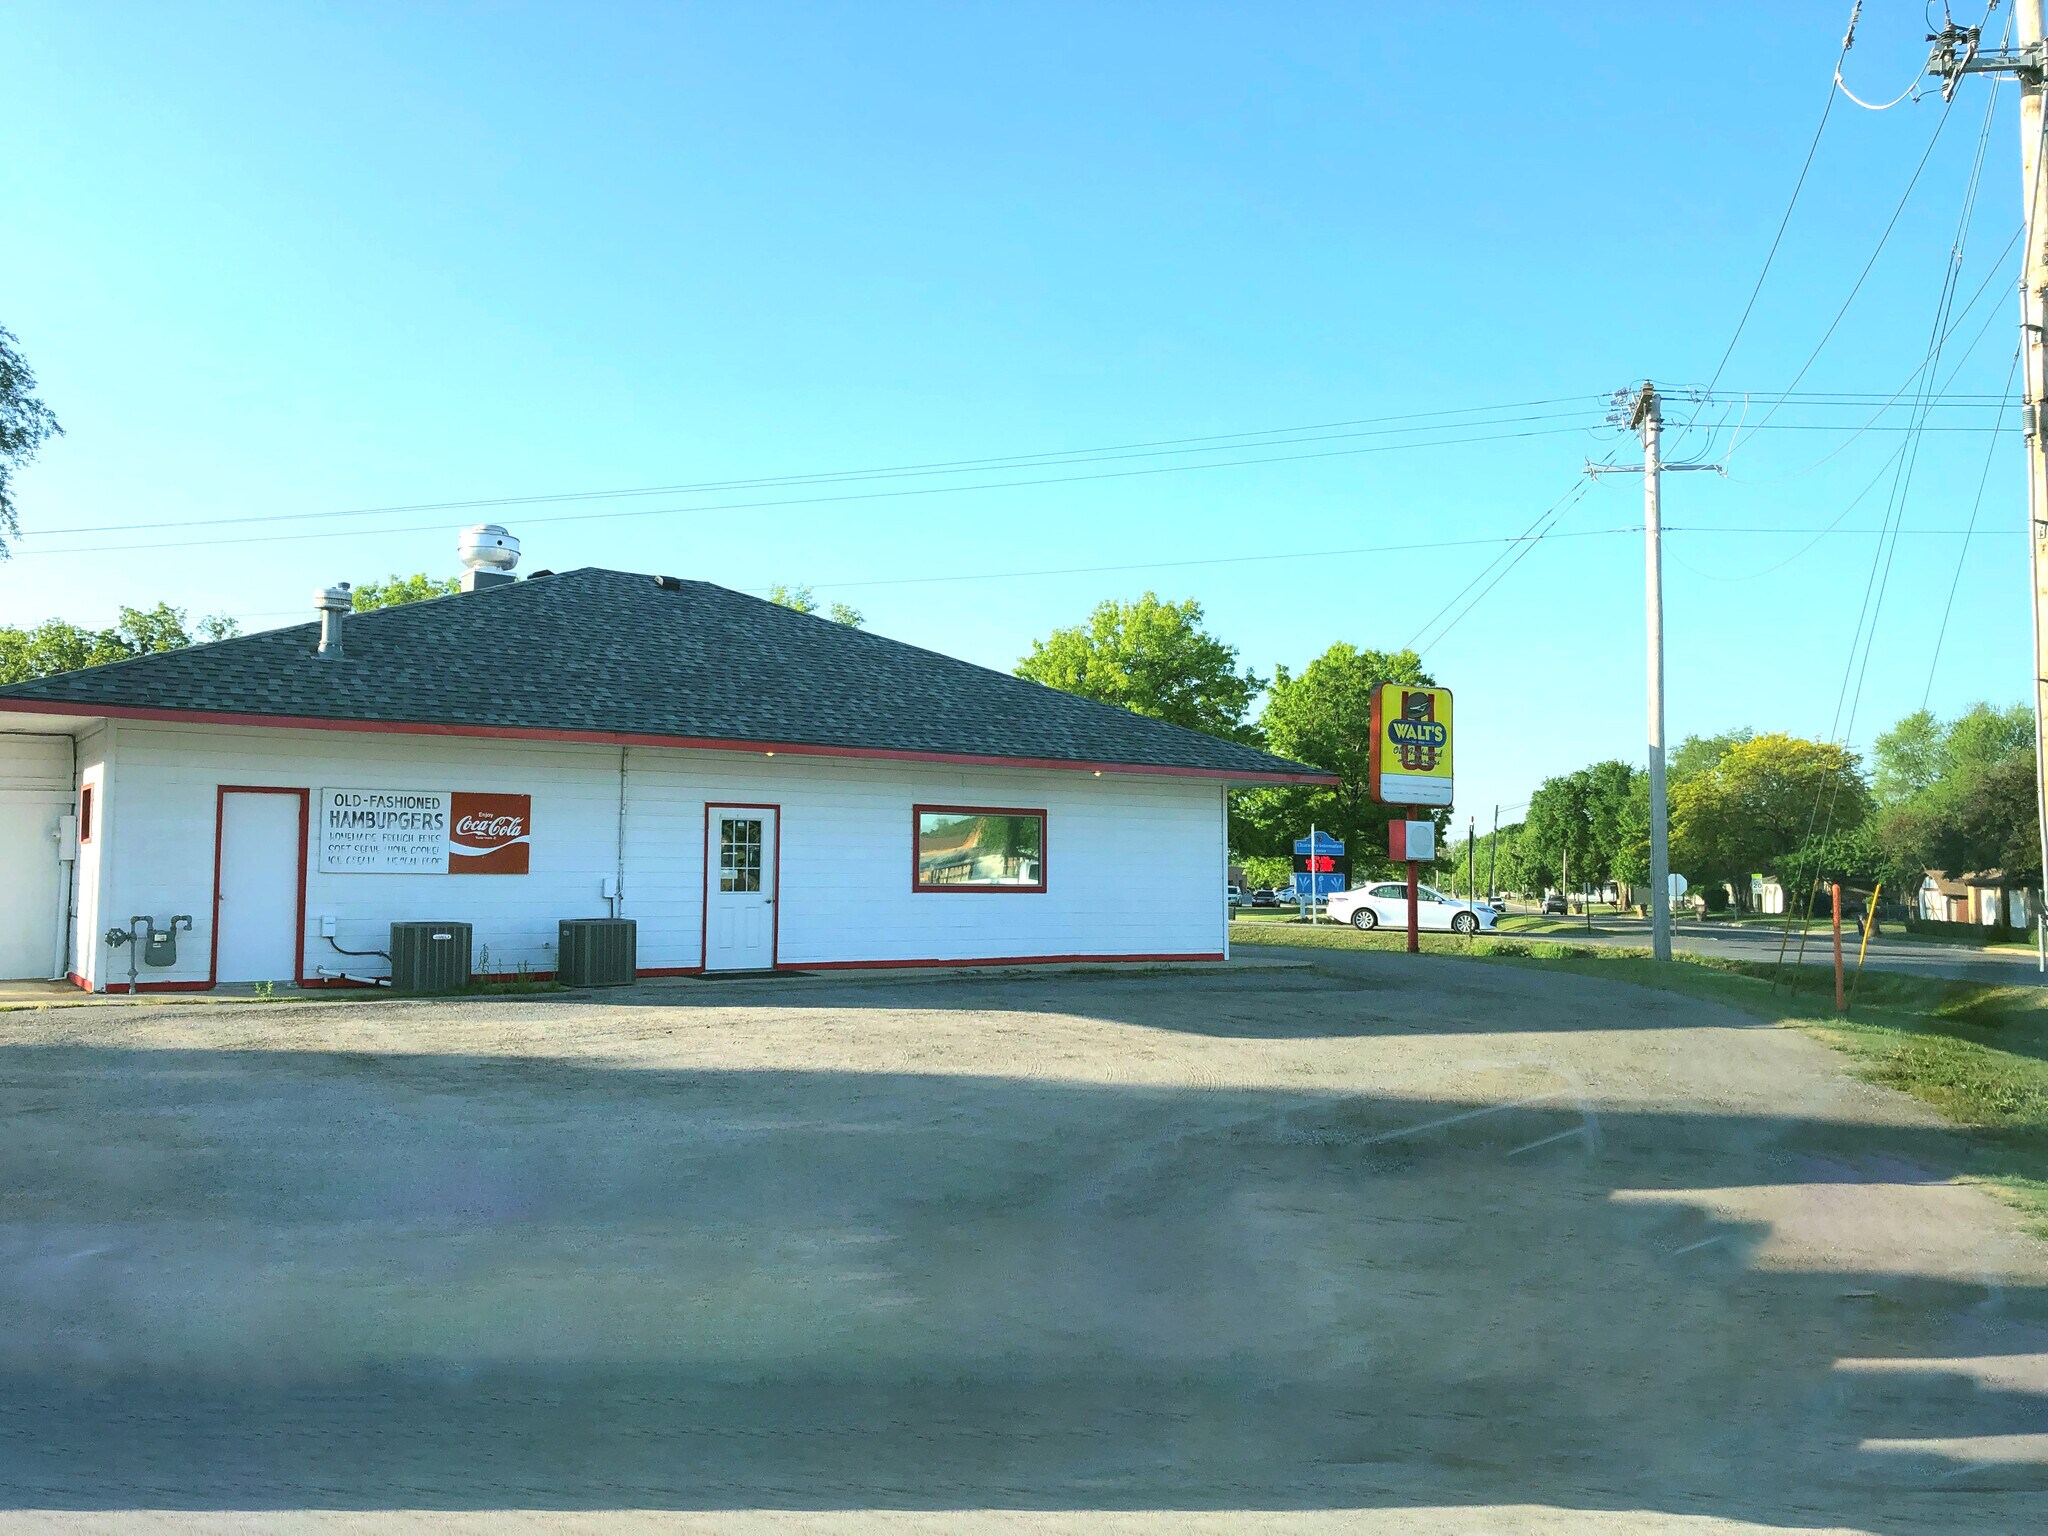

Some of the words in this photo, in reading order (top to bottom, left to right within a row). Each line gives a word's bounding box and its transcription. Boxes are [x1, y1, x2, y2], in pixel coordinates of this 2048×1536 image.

[1393, 723, 1443, 741] WALT'S
[334, 793, 441, 810] OLD-FASHIONED
[329, 810, 444, 830] HAMBURGERS
[456, 815, 525, 837] Coca-Cola
